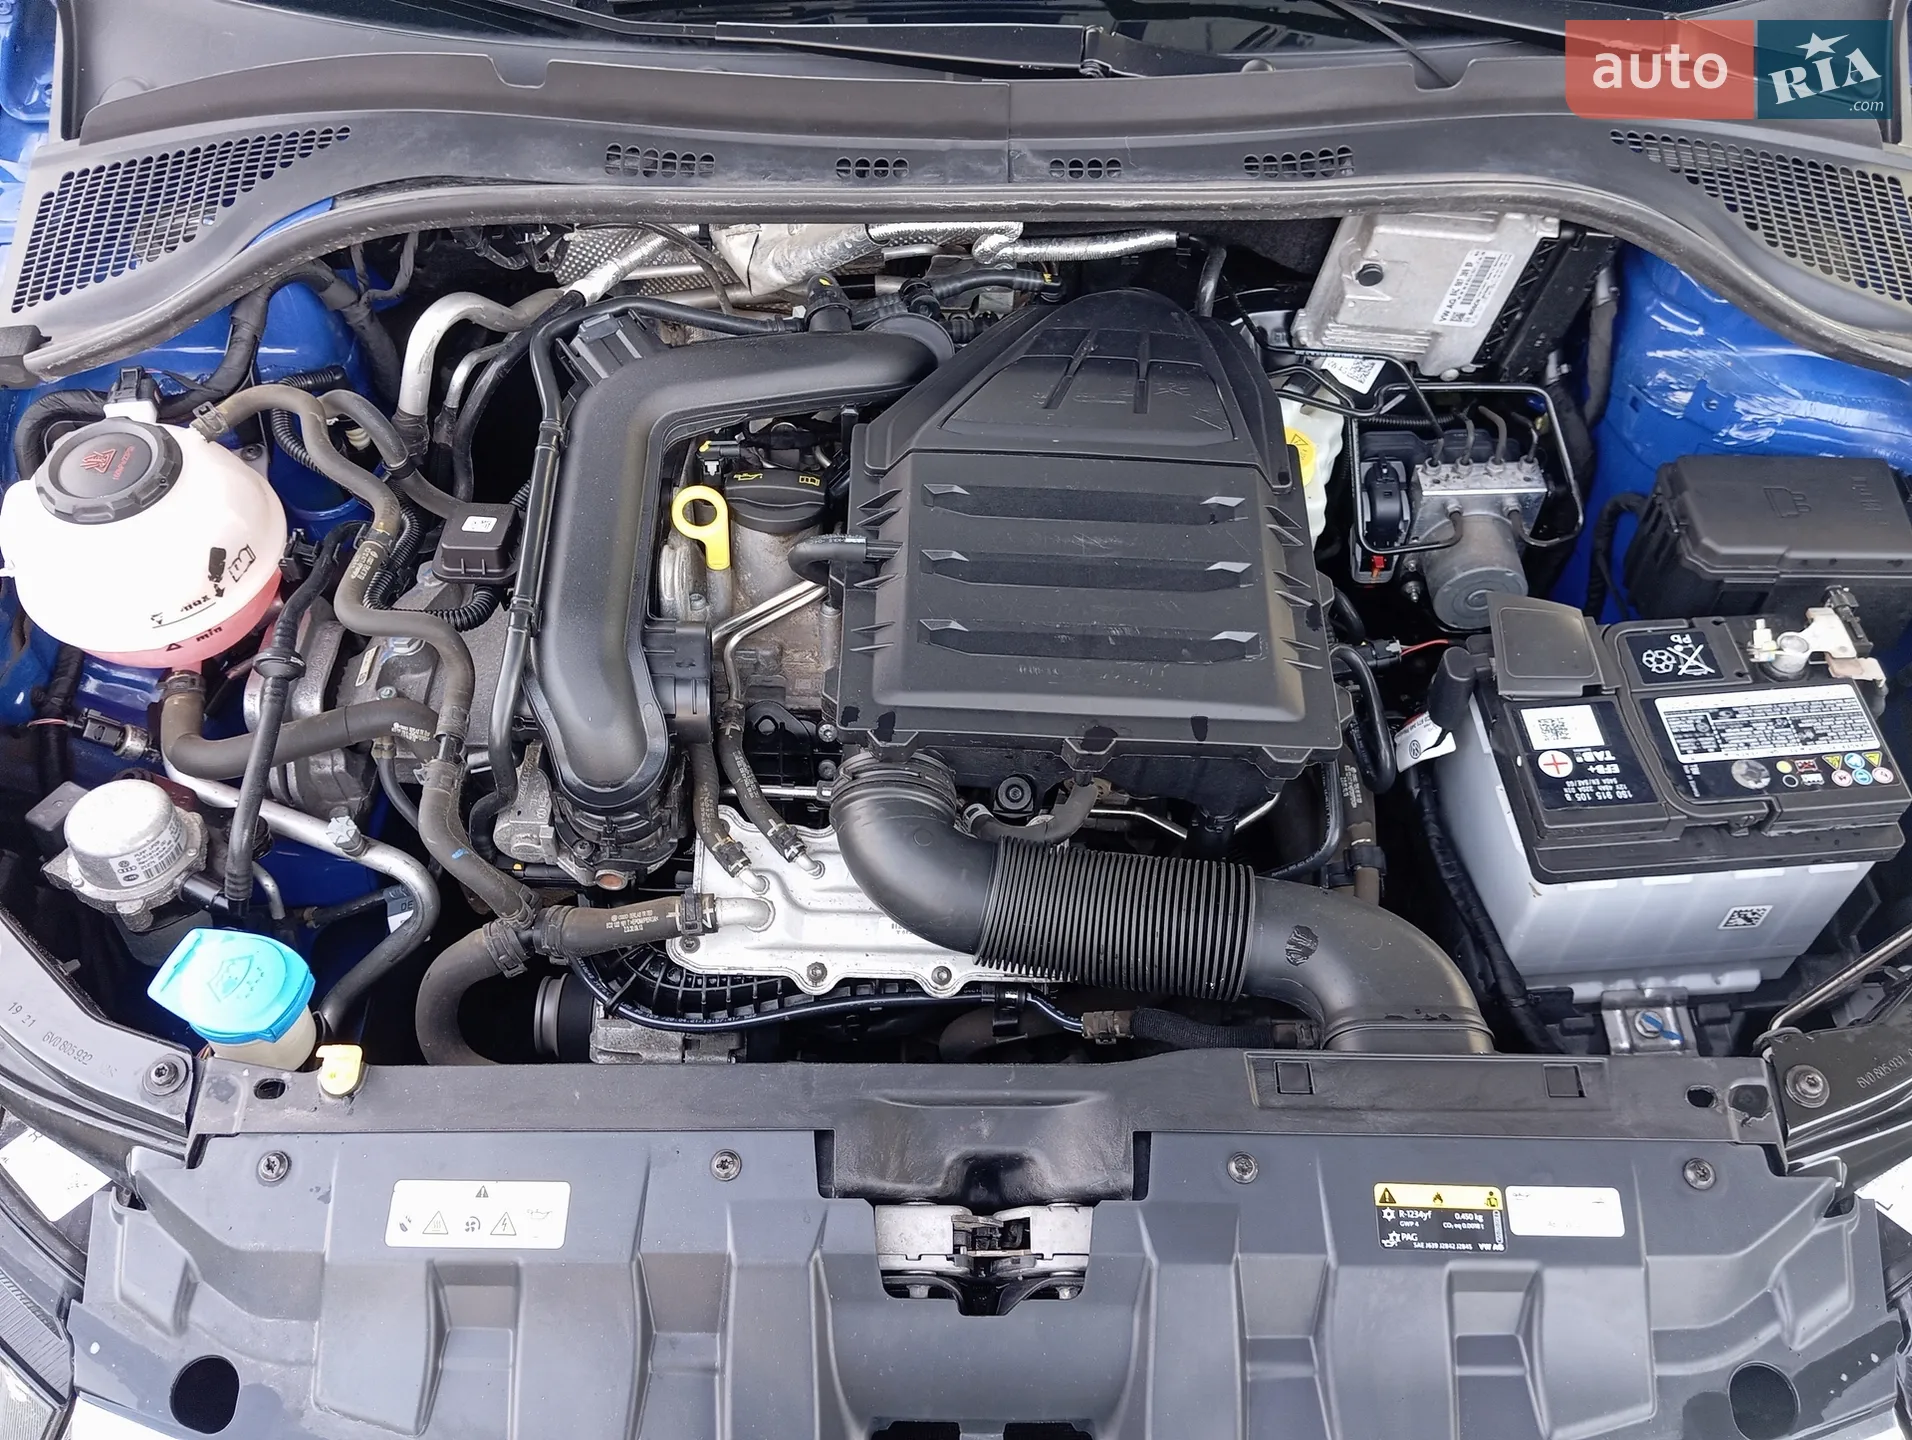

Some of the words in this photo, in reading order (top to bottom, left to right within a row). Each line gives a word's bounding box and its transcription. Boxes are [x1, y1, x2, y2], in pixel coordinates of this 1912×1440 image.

[196, 626, 223, 642] min
[1670, 633, 1693, 644] Pb
[1575, 793, 1592, 802] 105
[1595, 791, 1613, 800] 915
[8, 1002, 23, 1015] 19
[1398, 1210, 1432, 1221] R-1234yf
[1454, 1212, 1474, 1221] 0.450
[1474, 1213, 1484, 1223] kg
[1400, 1232, 1418, 1242] PAG
[1477, 1243, 1492, 1251] VW
